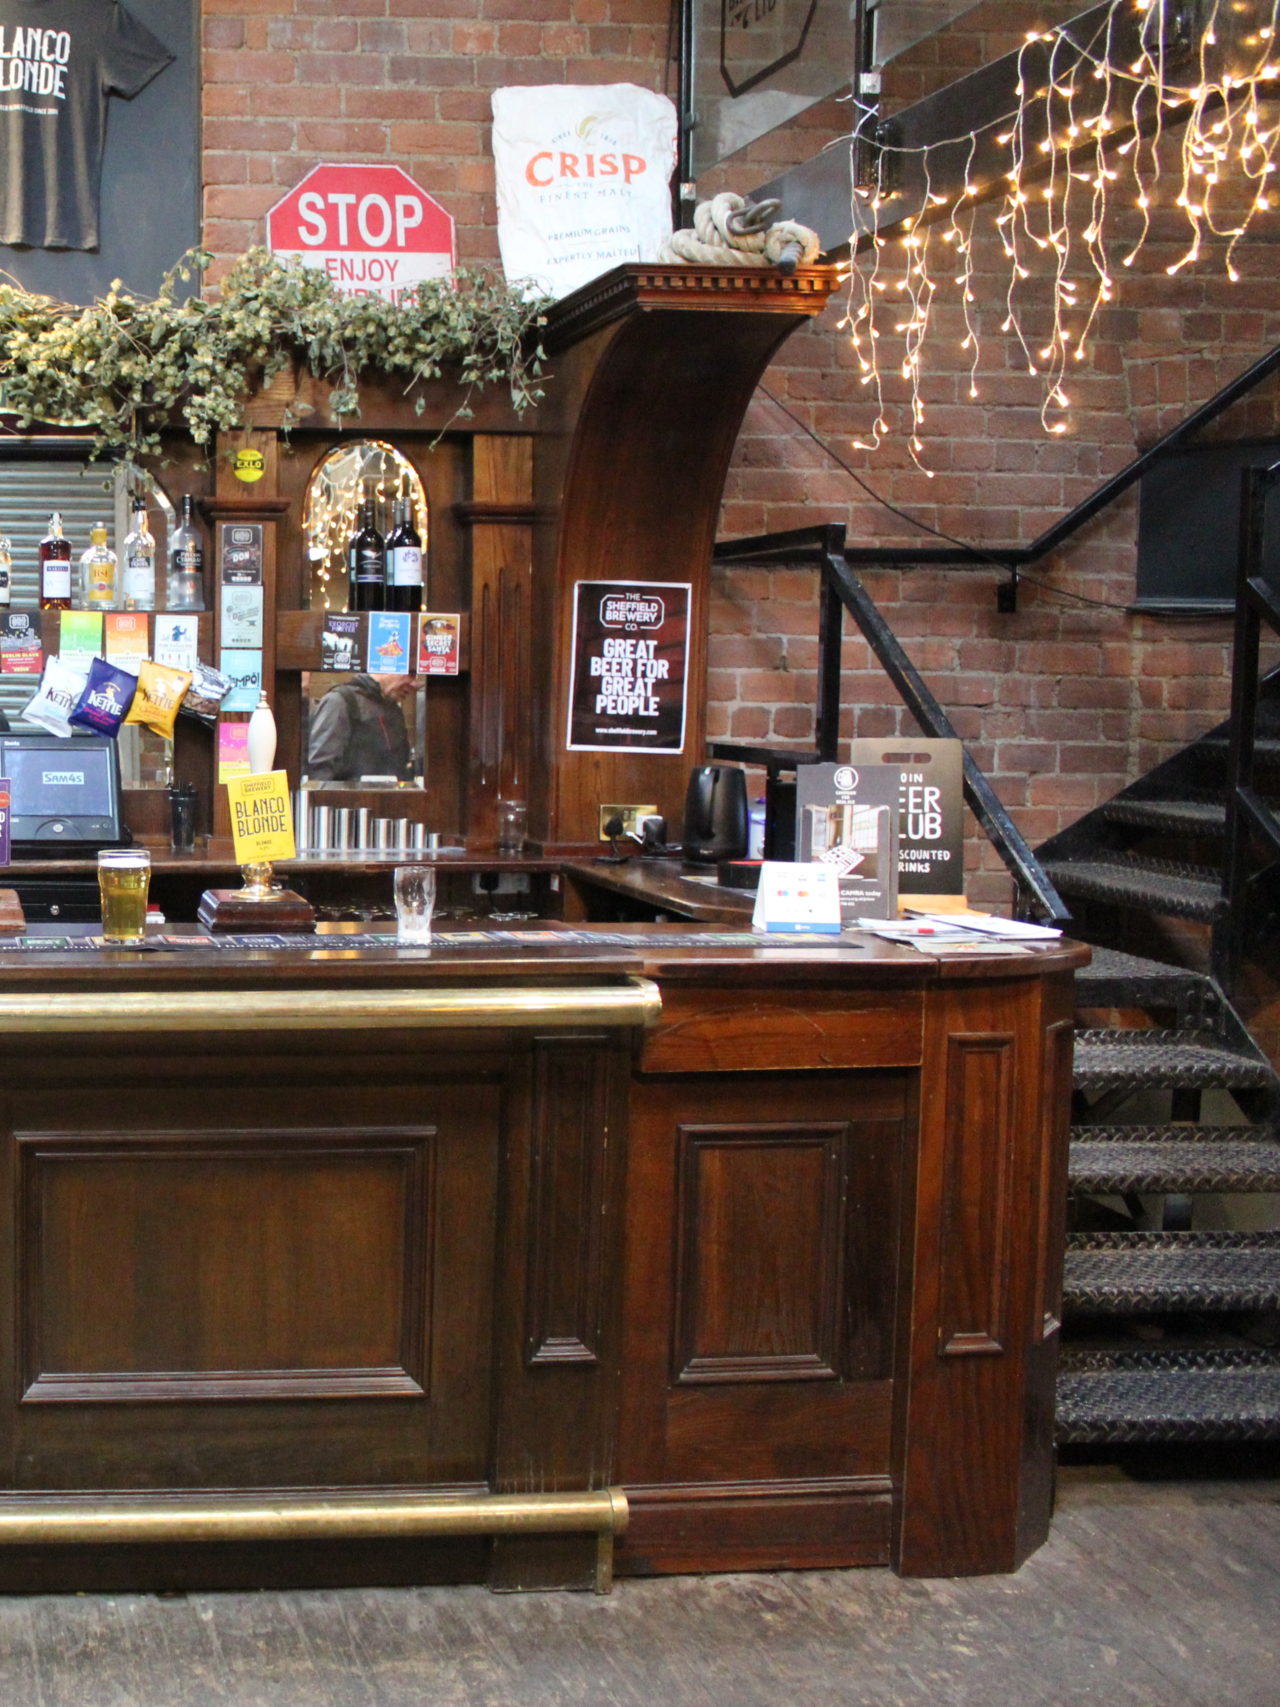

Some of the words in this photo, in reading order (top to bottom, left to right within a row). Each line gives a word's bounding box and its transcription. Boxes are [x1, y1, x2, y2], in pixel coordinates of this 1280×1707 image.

[525, 152, 647, 187] CRISP
[297, 192, 423, 247] STOP
[325, 258, 399, 282] ENJOY
[606, 601, 659, 612] SHEFFIELD
[625, 592, 641, 601] THE
[605, 611, 658, 622] BREWERY
[603, 638, 658, 660] GREAT
[590, 656, 634, 677] BEER
[636, 657, 670, 679] FOR
[601, 677, 656, 697] GREAT
[595, 695, 660, 717] PEOPLE
[900, 773, 923, 783] OIN
[235, 796, 285, 819] BLANCO
[237, 815, 288, 838] BLONDE
[899, 849, 951, 861] SCOUNTED
[897, 862, 931, 873] RINKS
